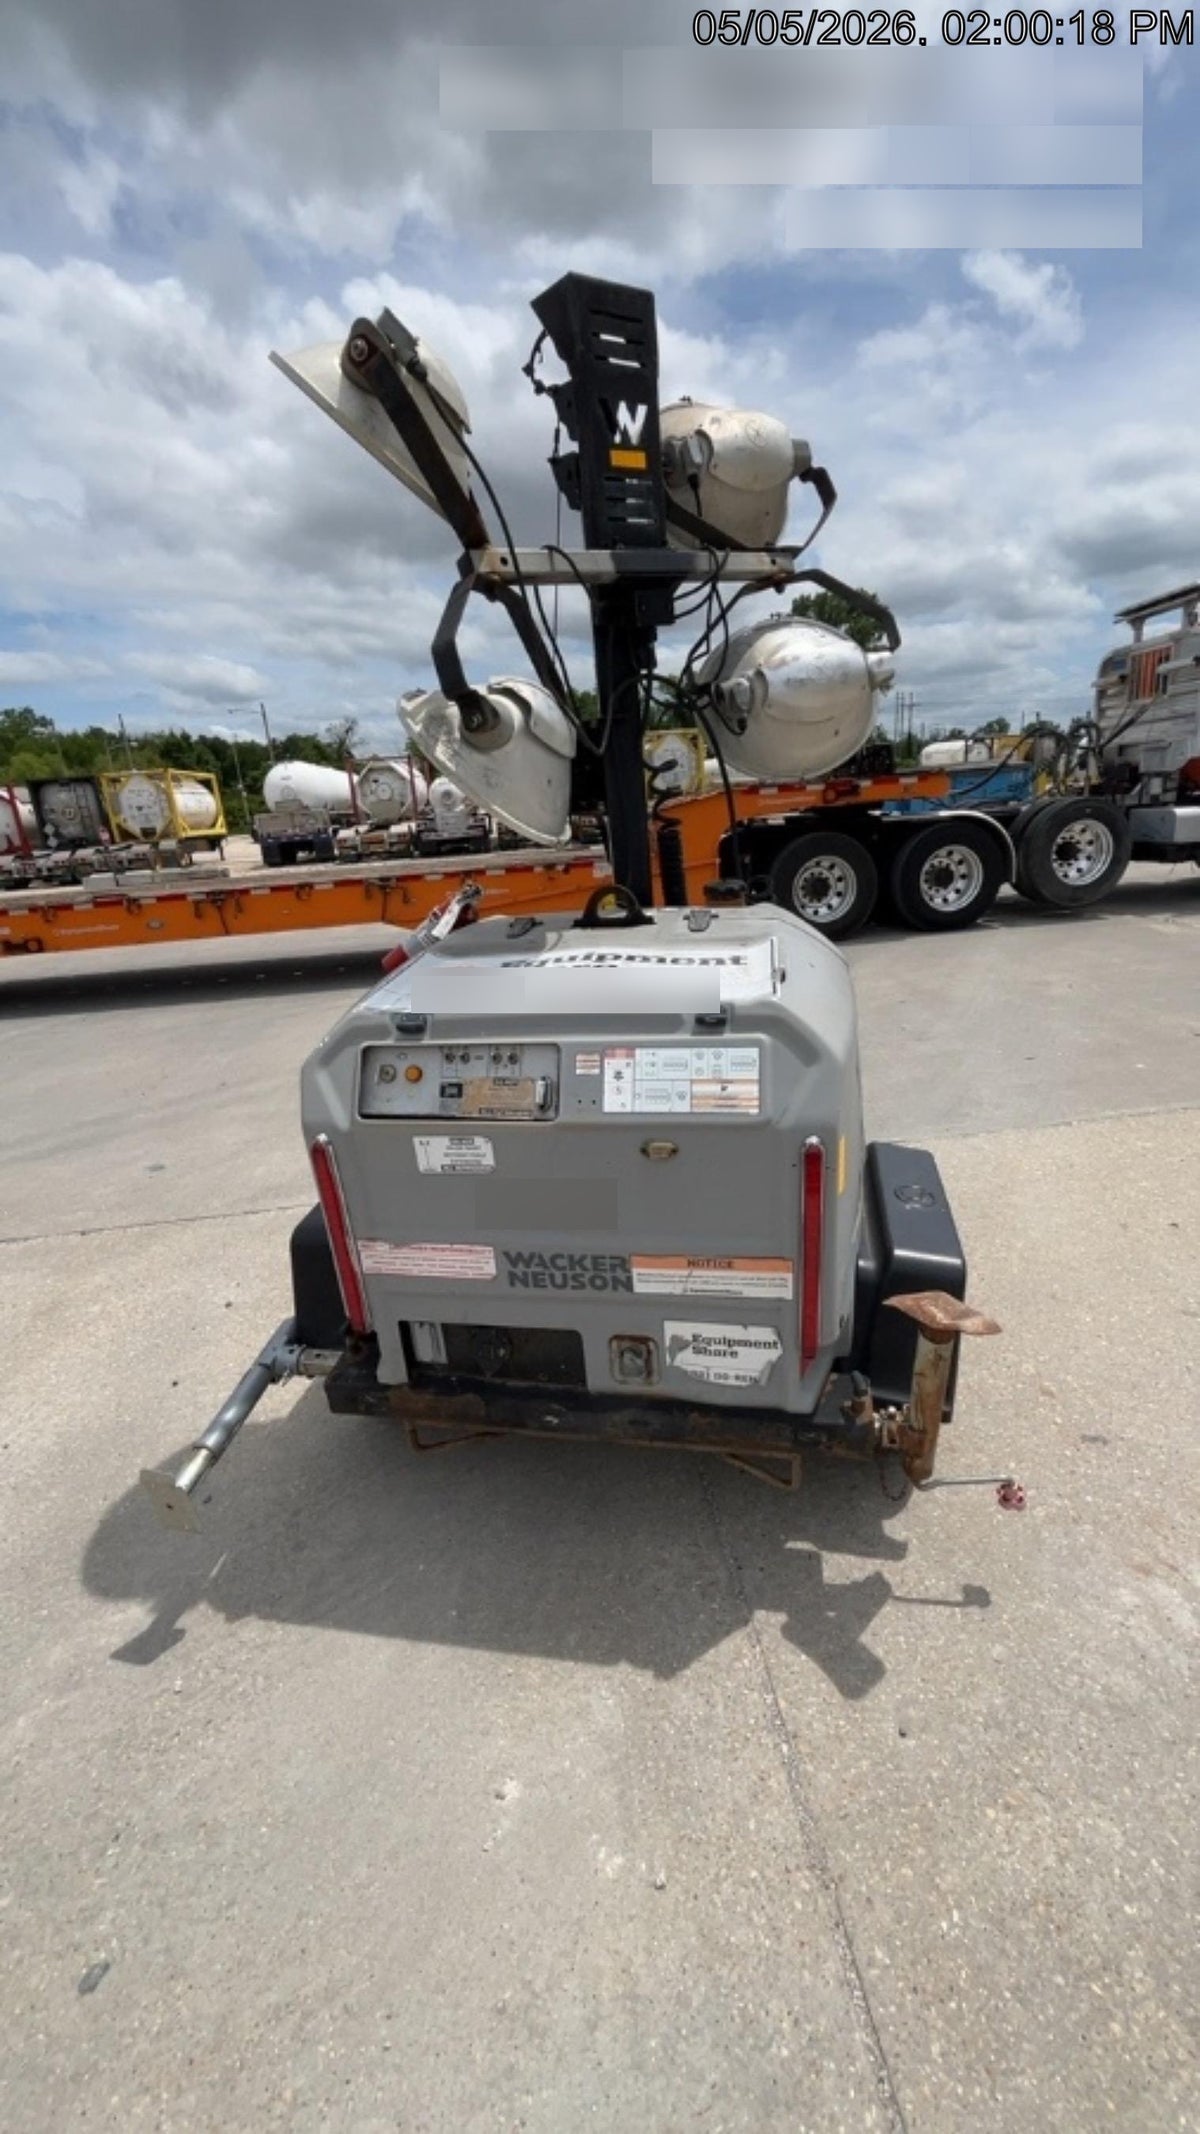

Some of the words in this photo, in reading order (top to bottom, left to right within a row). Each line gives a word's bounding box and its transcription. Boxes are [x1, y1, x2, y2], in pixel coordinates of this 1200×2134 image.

[502, 1251, 630, 1274] WACKER
[687, 1258, 735, 1270] NOTICE
[508, 1271, 633, 1293] NEUSON
[692, 1334, 779, 1350] Equipment
[692, 1347, 738, 1359] Share
